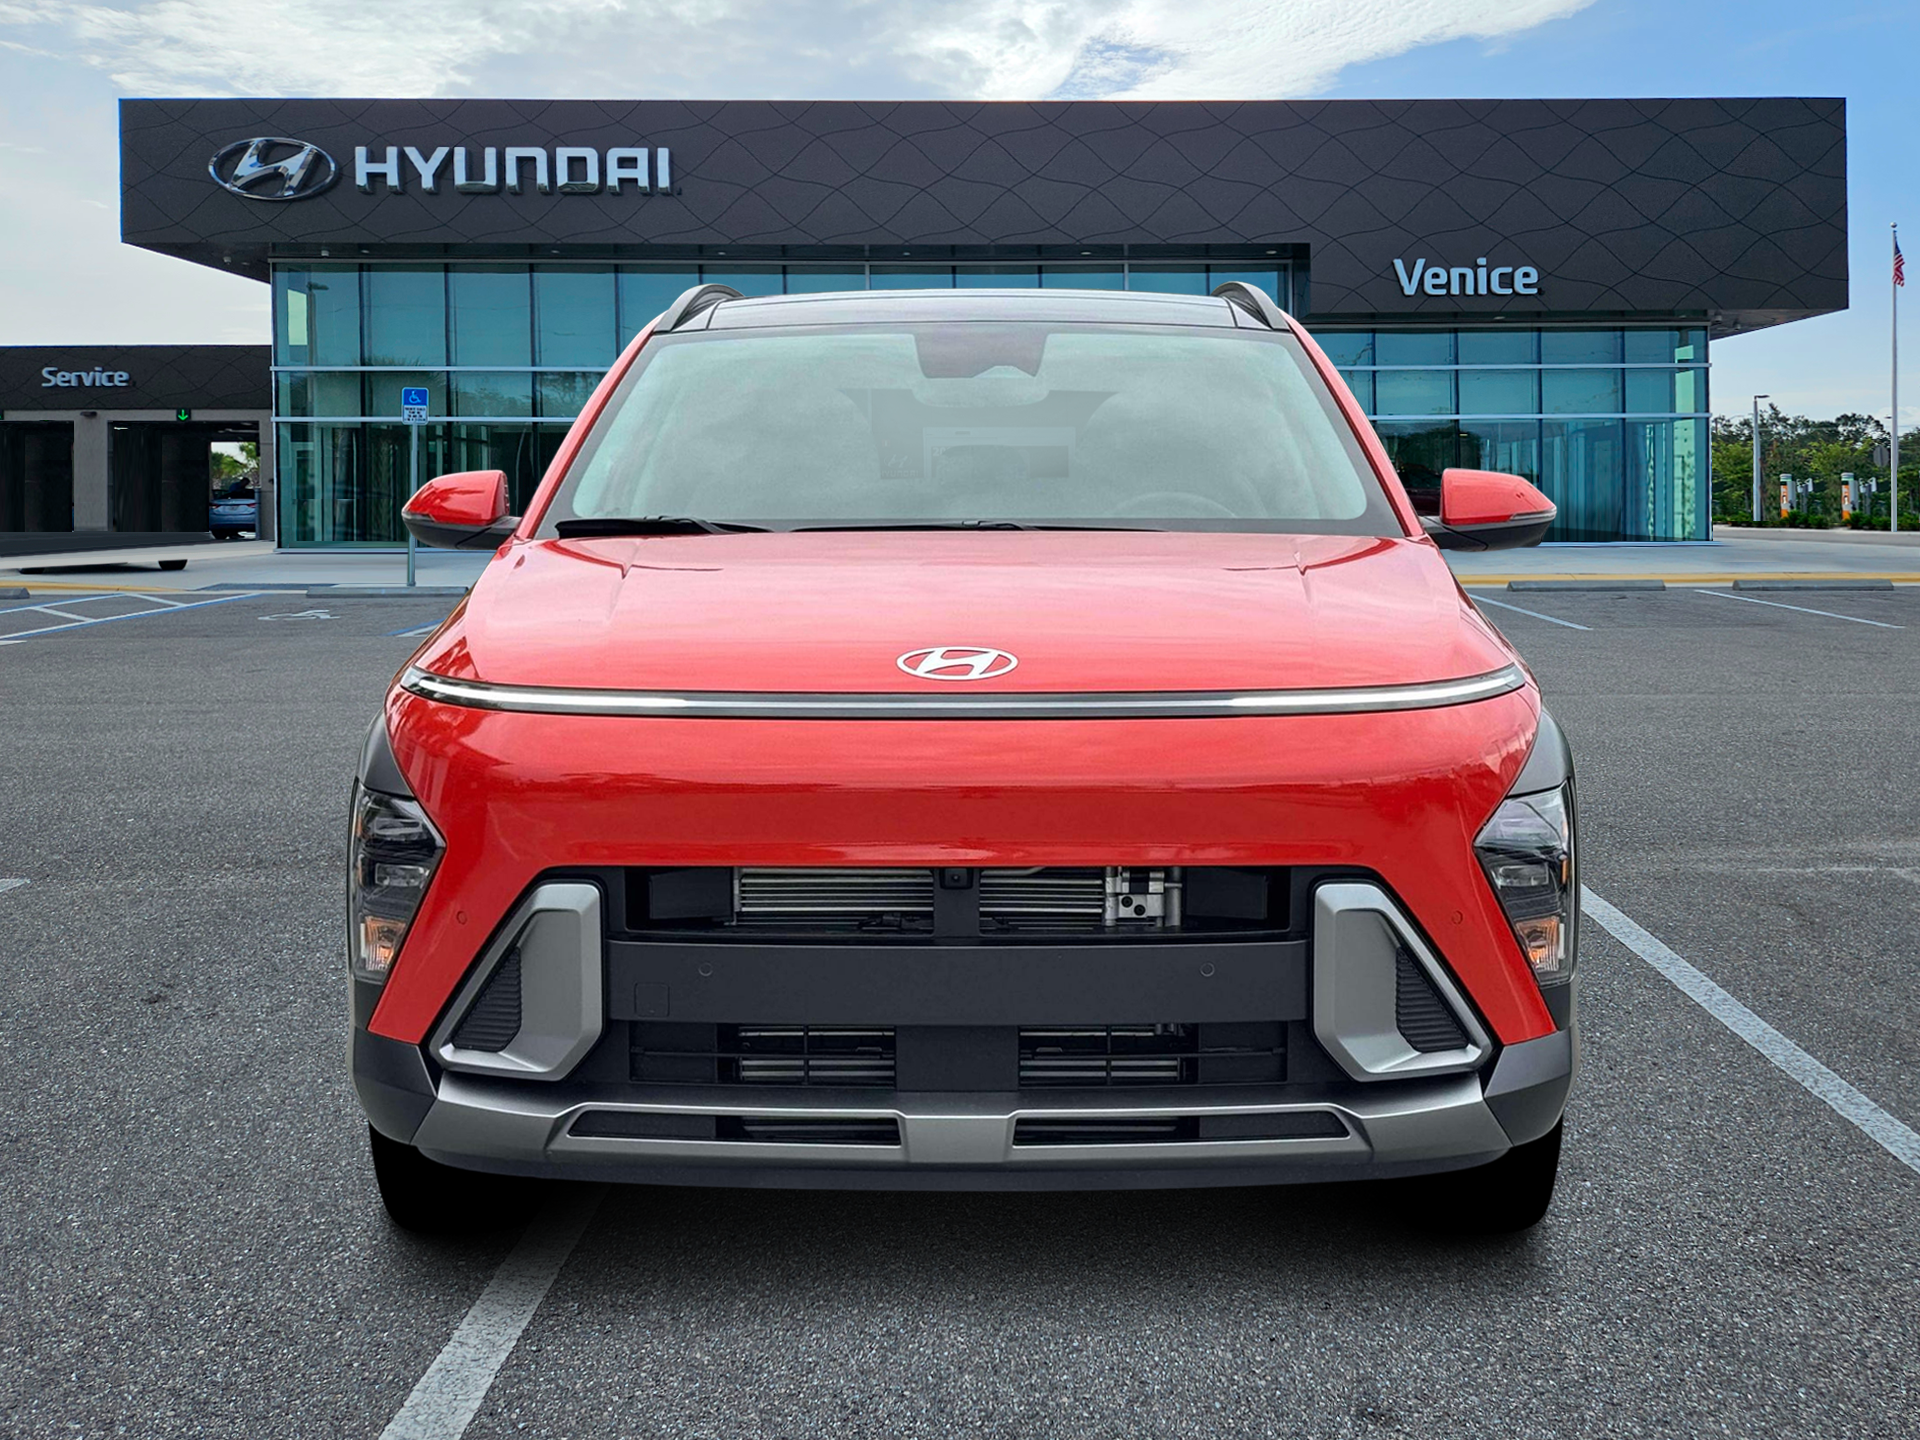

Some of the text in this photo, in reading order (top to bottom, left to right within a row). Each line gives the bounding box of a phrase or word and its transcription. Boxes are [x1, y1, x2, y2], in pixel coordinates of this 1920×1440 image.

[354, 146, 673, 194] HYUNDAI
[1393, 257, 1539, 296] Venice
[41, 366, 130, 387] Service
